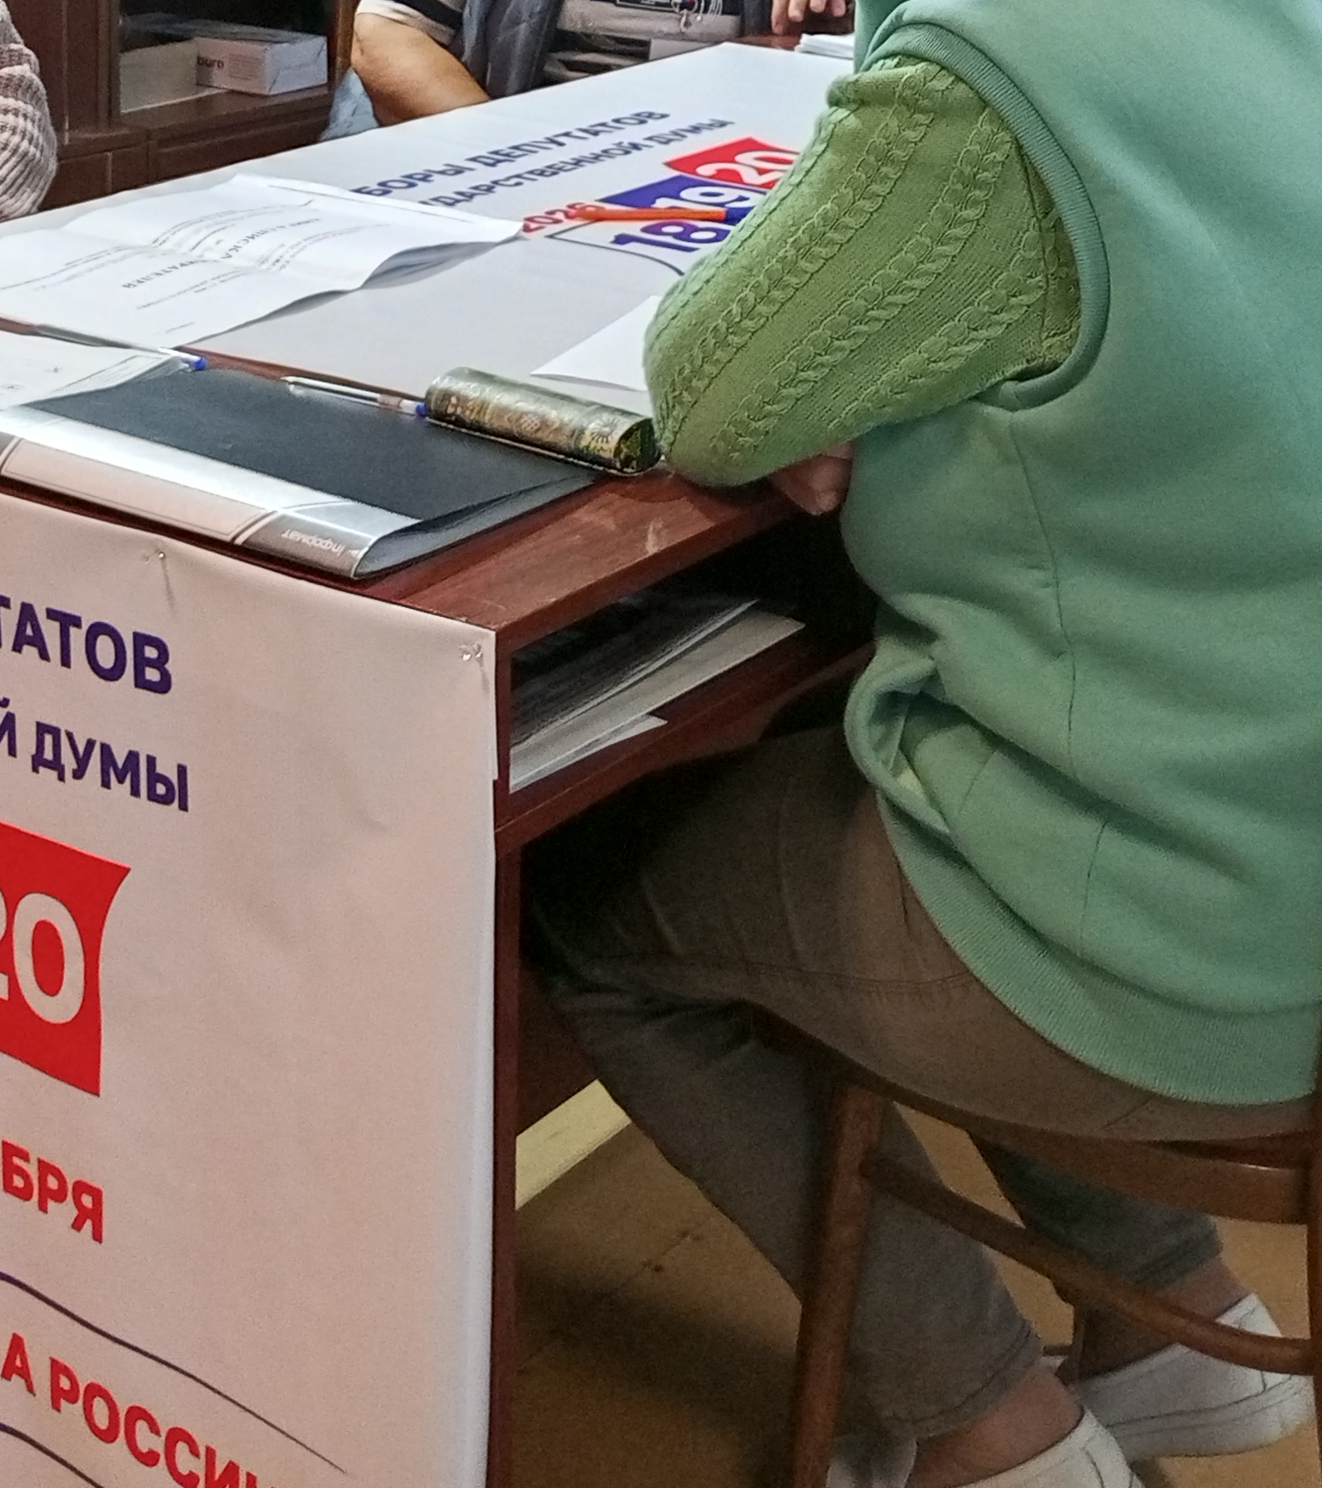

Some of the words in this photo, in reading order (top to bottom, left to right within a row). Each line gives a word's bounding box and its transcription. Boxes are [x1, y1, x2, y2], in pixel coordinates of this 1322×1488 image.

[349, 163, 476, 197] БОРЫ
[465, 110, 671, 168] ДЕПУТАТОВ
[418, 141, 654, 207] ДАРСТВЕННОЙ
[643, 118, 735, 146] ДУМЫ
[609, 220, 732, 253] 18
[30, 720, 190, 811] ДУМЫ
